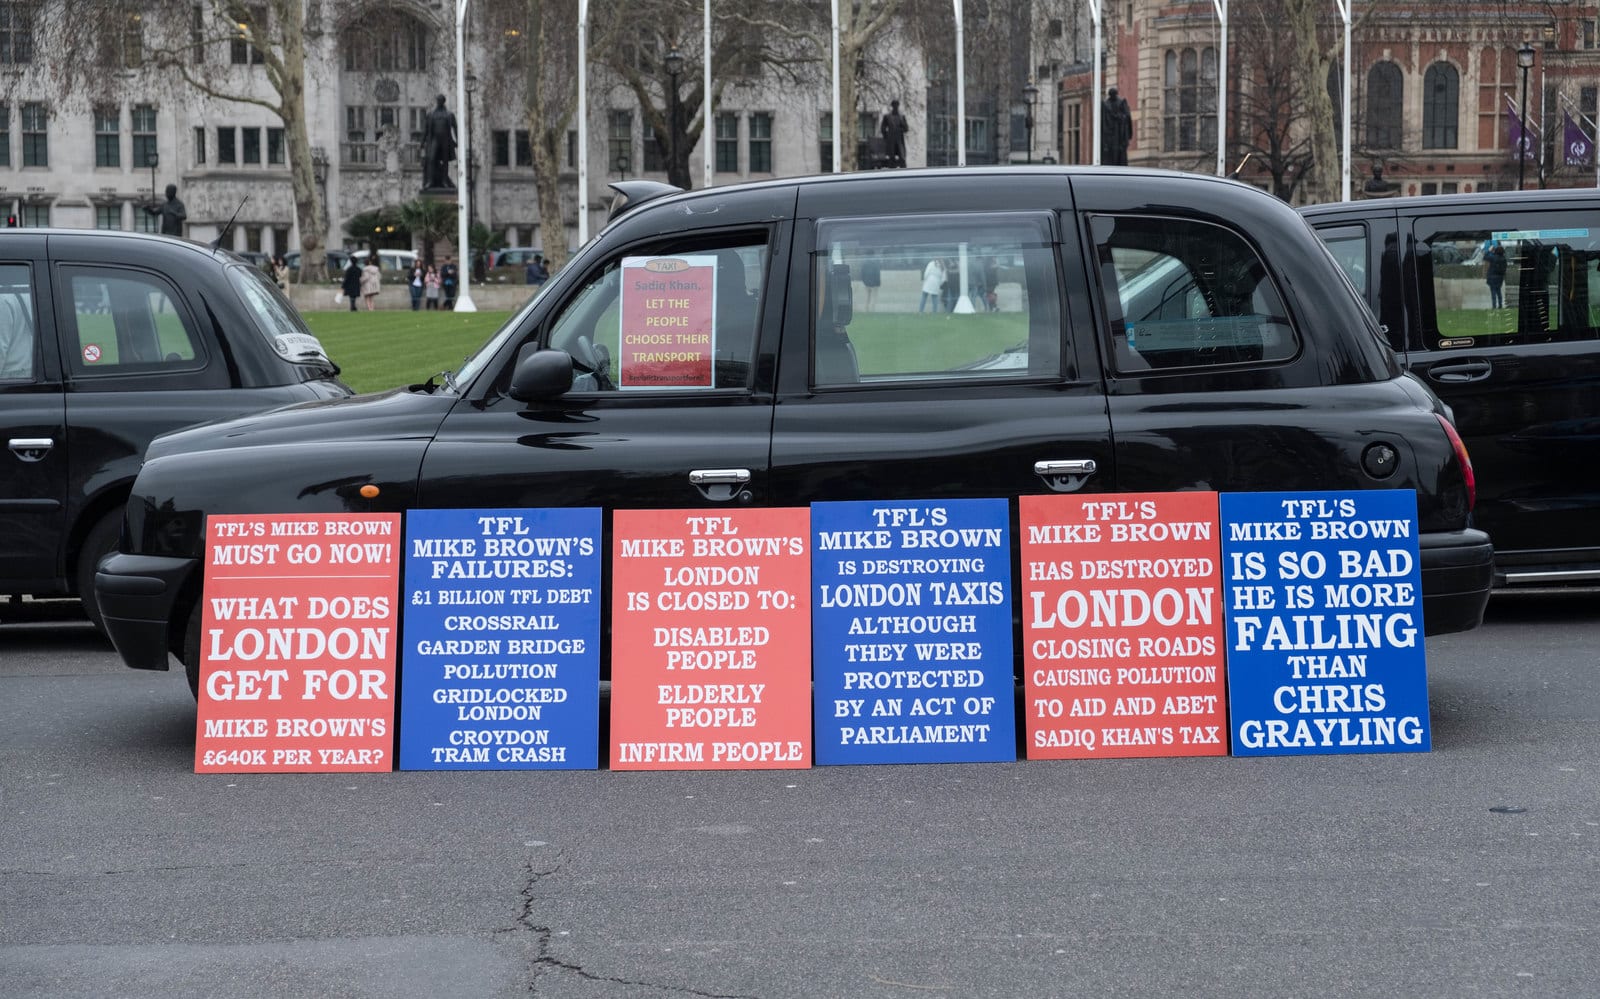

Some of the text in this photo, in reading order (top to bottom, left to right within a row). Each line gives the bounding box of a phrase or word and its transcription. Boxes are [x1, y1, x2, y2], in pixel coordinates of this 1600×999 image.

[656, 262, 676, 270] TAXI
[635, 281, 666, 292] Sadiq
[646, 299, 689, 308] LET THE
[646, 317, 688, 326] PEOPLE
[626, 334, 709, 344] CHOOSE THEIR
[632, 352, 701, 362] TRANSPORT
[873, 508, 947, 526] TFL'S
[1082, 502, 1156, 520] TFL'S
[1282, 500, 1355, 518] TFL'S
[215, 521, 392, 536] TFL’S MIKE BROWN
[479, 517, 529, 535] TFL
[686, 517, 738, 535] TFL
[1029, 522, 1211, 544] MIKE BROWN
[1230, 520, 1410, 540] MIKE BROWN
[414, 538, 593, 557] MIKE BROWN’S
[621, 537, 803, 557] MIKE BROWN’S
[820, 529, 1001, 549] MIKE BROWN
[213, 544, 391, 565] MUST GO NOW!
[432, 560, 572, 578] FAILURES:
[839, 559, 984, 574] IS DESTROYING
[1030, 559, 1212, 580] HAS DESTROYED
[1231, 550, 1412, 579] IS SO BAD
[664, 566, 760, 586] LONDON
[412, 589, 592, 604] £1 BILLION TFL DEBT
[627, 590, 795, 611] IS CLOSED TO:
[821, 582, 1003, 607] LONDON TAXIS
[1233, 584, 1414, 609] HE IS MORE
[211, 597, 389, 620] WHAT DOES
[1031, 588, 1214, 628] LONDON
[445, 616, 559, 630] CROSSRAIL
[849, 616, 976, 634] ALTHOUGH
[1234, 614, 1417, 650] FAILING
[208, 627, 390, 660] LONDON
[654, 626, 769, 646] DISABLED
[418, 640, 585, 654] GARDEN BRIDGE
[845, 643, 981, 661] THEY WERE
[1033, 636, 1215, 659] CLOSING ROADS
[666, 650, 756, 670] PEOPLE
[1287, 655, 1366, 678] THAN
[444, 664, 557, 679] POLLUTION
[844, 671, 983, 689] PROTECTED
[1034, 666, 1216, 686] CAUSING POLLUTION
[207, 669, 388, 701] GET FOR
[658, 684, 765, 704] ELDERLY
[433, 689, 567, 703] GRIDLOCKED
[1274, 685, 1385, 713] CHRIS
[458, 706, 541, 720] LONDON
[835, 698, 994, 717] BY AN ACT OF
[1034, 696, 1217, 717] TO AID AND ABET
[666, 708, 756, 727] PEOPLE
[204, 718, 386, 737] MIKE BROWN'S
[841, 725, 990, 744] PARLIAMENT
[1240, 717, 1423, 747] GRAYLING
[450, 730, 548, 745] CROYDON
[1035, 727, 1219, 750] SADIQ KHAN'S TAX
[203, 749, 384, 765] £640K PER YEAR?
[432, 748, 565, 762] TRAM CRASH
[619, 742, 803, 762] INFIRM PEOPLE
